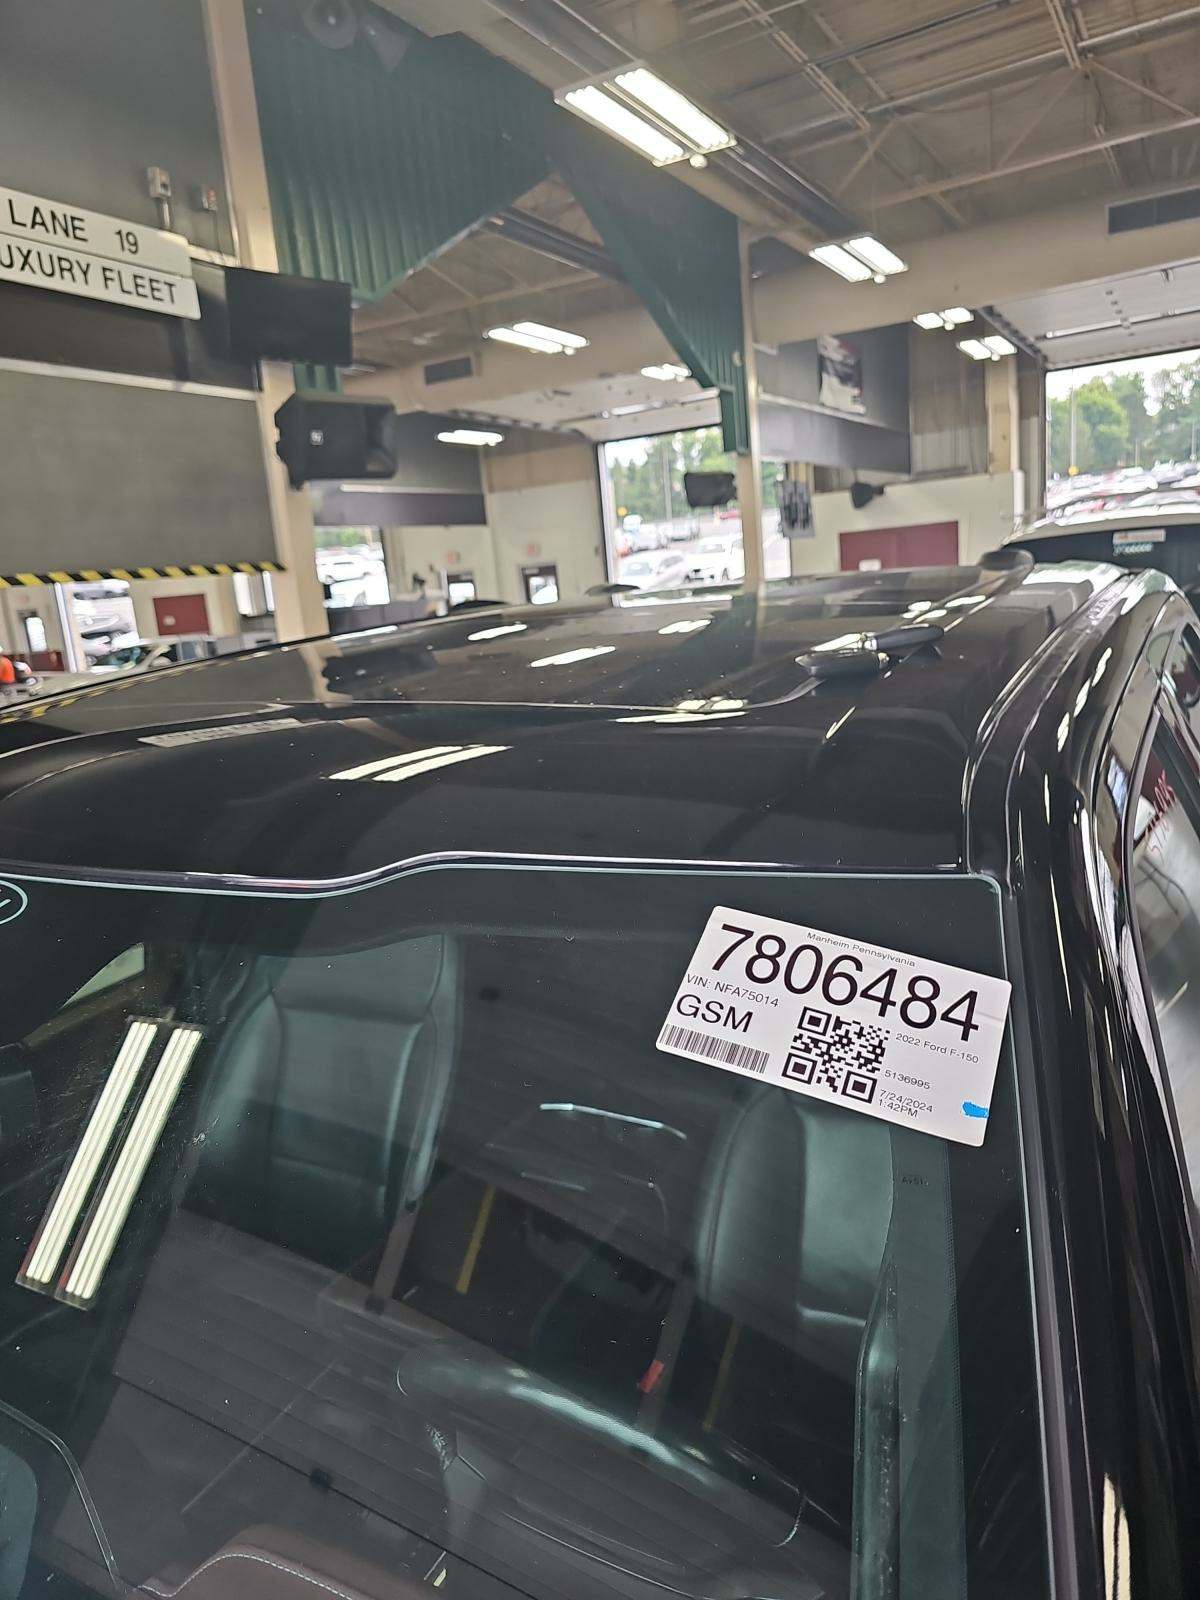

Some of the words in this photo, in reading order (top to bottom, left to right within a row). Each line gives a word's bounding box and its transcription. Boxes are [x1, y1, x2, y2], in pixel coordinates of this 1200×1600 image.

[8, 198, 89, 242] LANE
[114, 228, 140, 255] 19
[102, 266, 177, 305] FLEET
[806, 931, 850, 950] Manheim
[852, 943, 916, 967] Pennsylvania
[686, 973, 711, 991] VIN:
[714, 981, 780, 1008] NFA75014
[711, 923, 980, 1042] 7806484
[675, 993, 754, 1033] GSM
[895, 1032, 920, 1048] 2022
[921, 1040, 948, 1055] Ford
[949, 1048, 980, 1064] F-150
[884, 1069, 931, 1090] 5136995
[878, 1098, 919, 1118] 1:42PM
[879, 1088, 934, 1113] 7/24/2024
